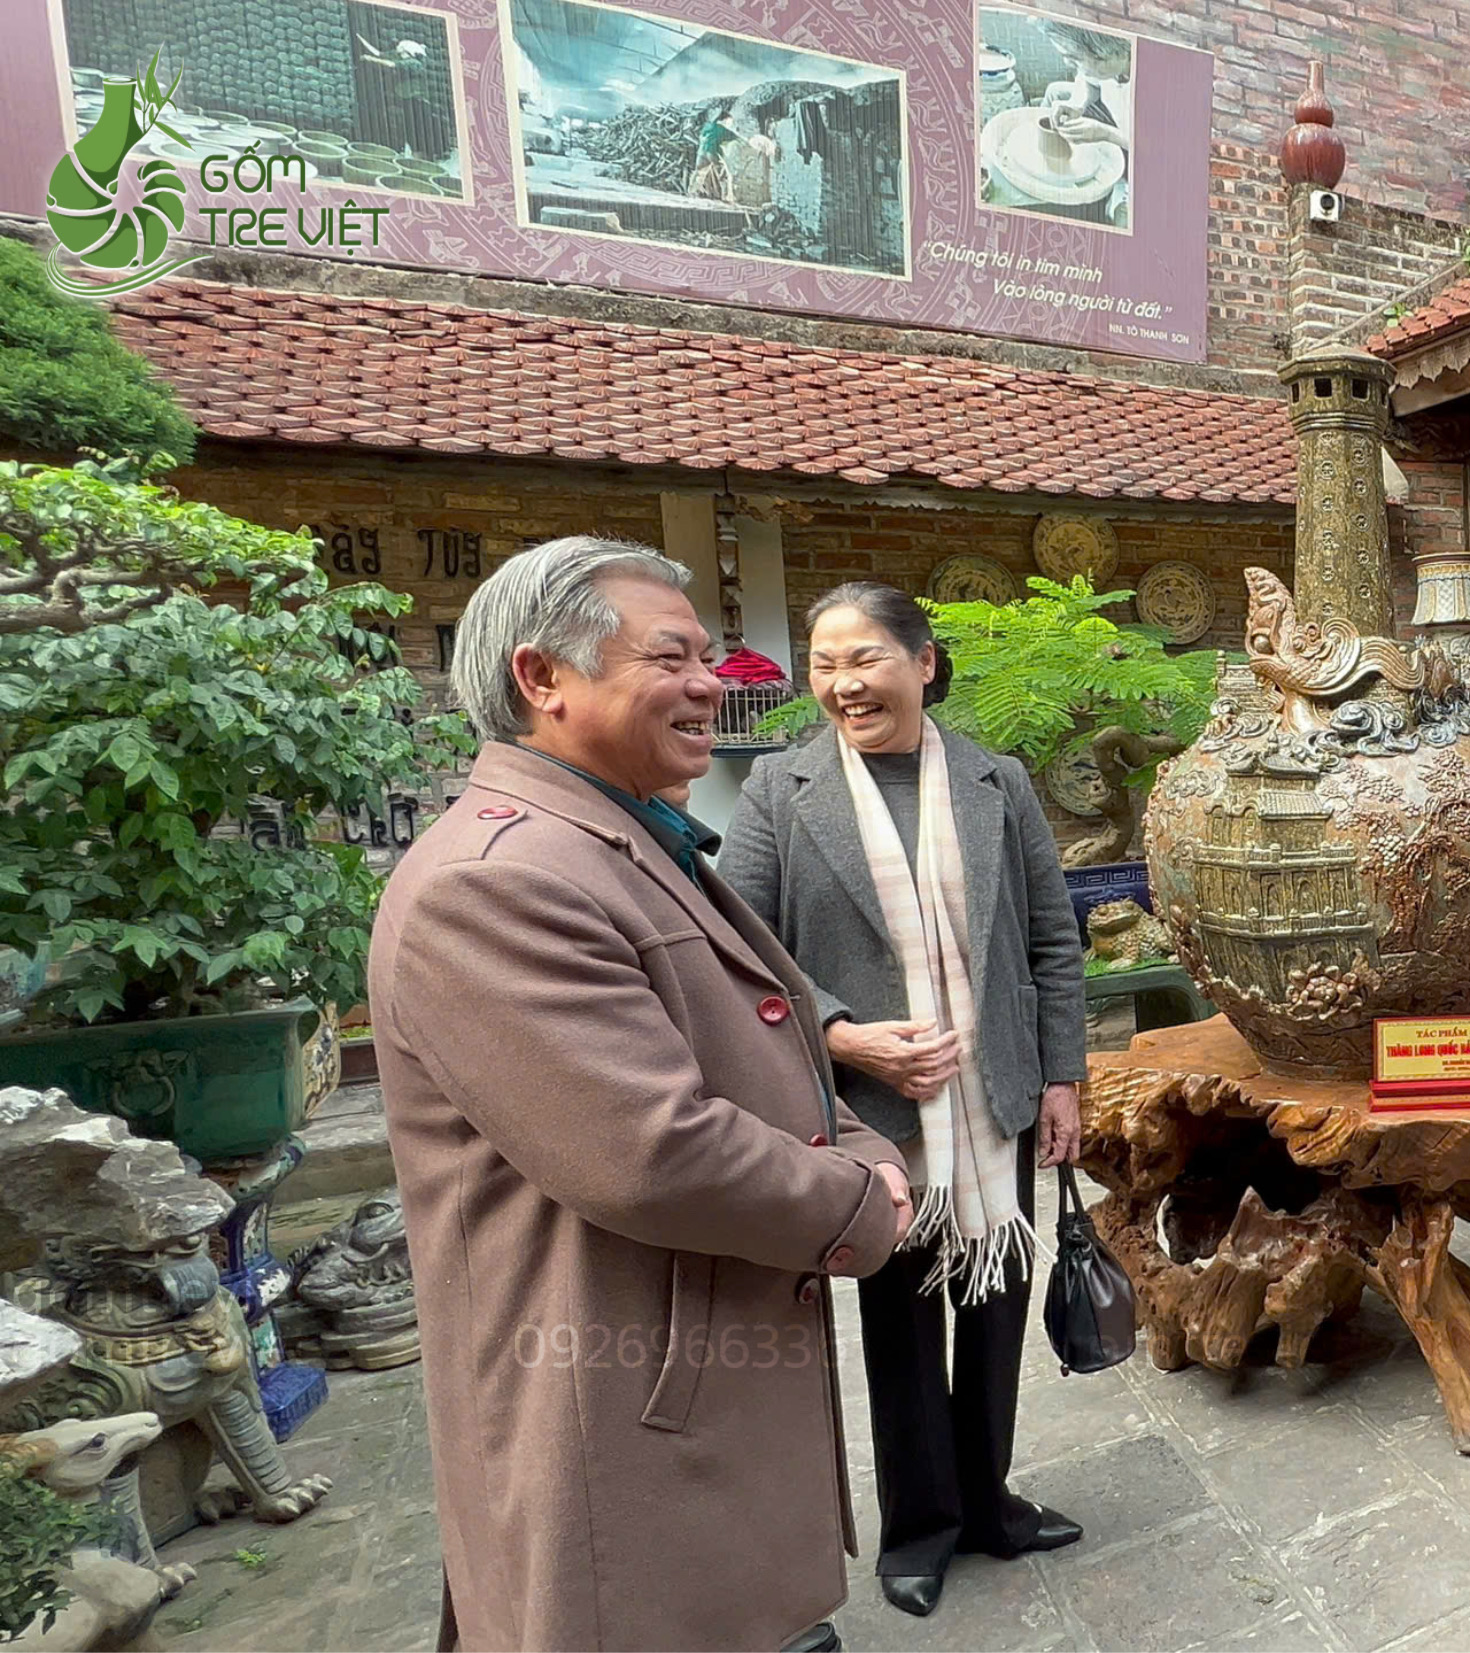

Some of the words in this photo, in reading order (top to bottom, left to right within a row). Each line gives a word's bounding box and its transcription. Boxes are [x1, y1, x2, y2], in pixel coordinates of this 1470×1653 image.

[991, 250, 1015, 268] tôi
[1016, 254, 1031, 271] in
[1034, 257, 1061, 276] tim
[1062, 263, 1103, 284] mình
[994, 278, 1027, 299] Vào
[1028, 284, 1067, 308] lòng
[1115, 297, 1134, 315] từ
[1139, 328, 1168, 341] THANH
